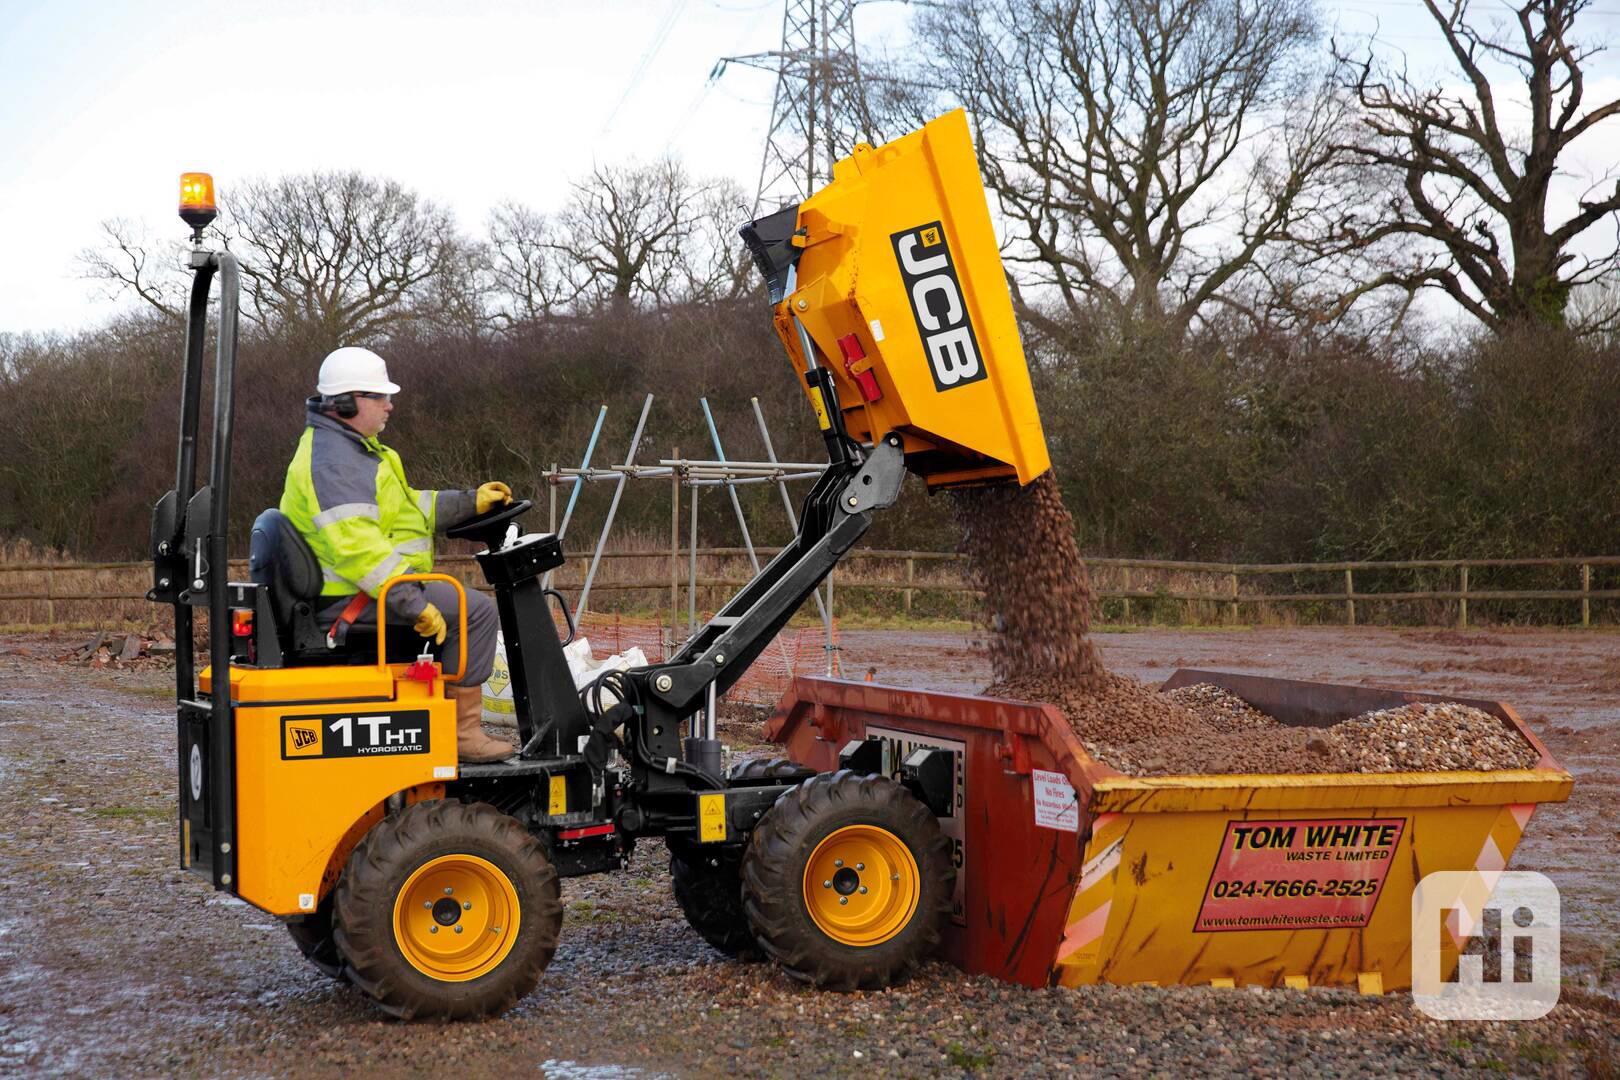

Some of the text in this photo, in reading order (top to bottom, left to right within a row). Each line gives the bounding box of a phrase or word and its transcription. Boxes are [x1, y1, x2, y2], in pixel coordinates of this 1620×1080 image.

[898, 233, 979, 385] JCB
[294, 729, 317, 747] JCB
[358, 745, 422, 753] HYDROSTATIC
[1233, 825, 1398, 850] TOM WHITE
[1286, 850, 1389, 861] WASTE LIMITED
[1213, 878, 1379, 898] 024-7666-2525
[1202, 913, 1366, 927] www.tomwhitewaste.co.uk
